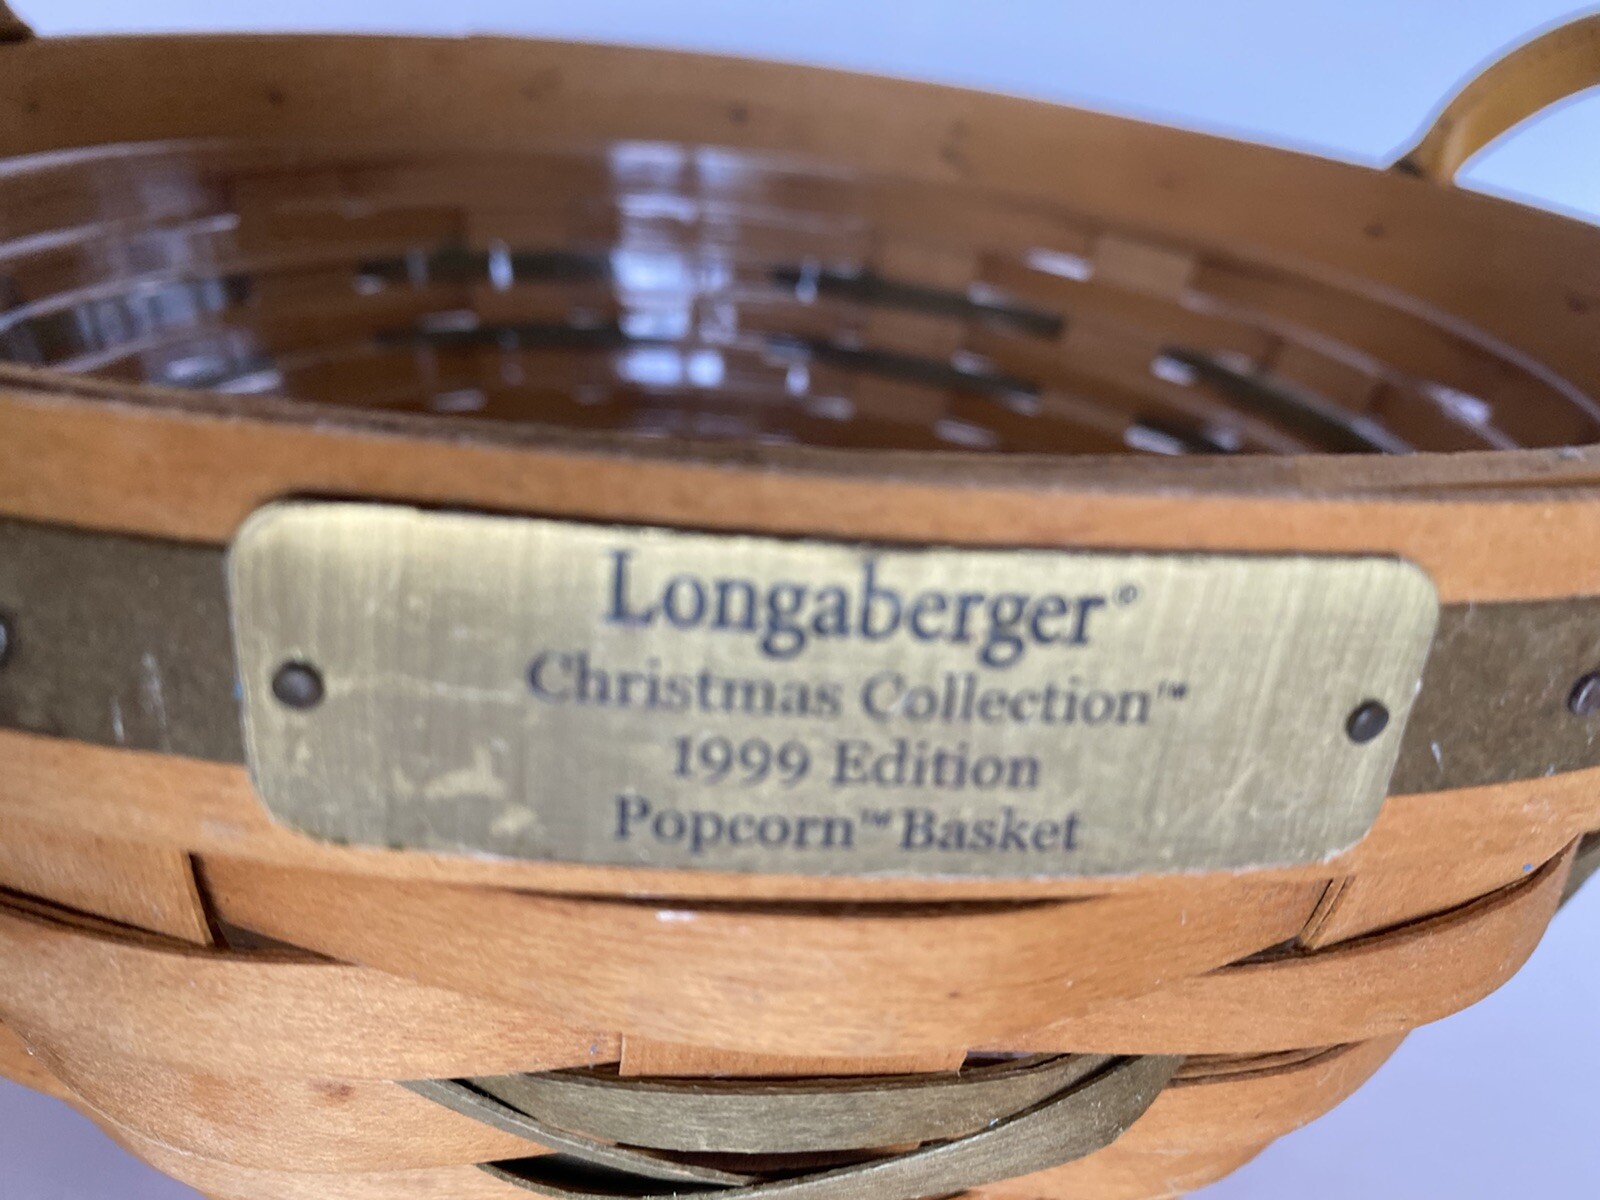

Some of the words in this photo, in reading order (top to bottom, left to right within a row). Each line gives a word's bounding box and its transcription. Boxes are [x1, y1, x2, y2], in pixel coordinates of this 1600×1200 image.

[525, 650, 842, 720] Christmas
[673, 735, 812, 788] 1999
[831, 738, 1040, 792] Edition
[900, 806, 1080, 853] Basket
